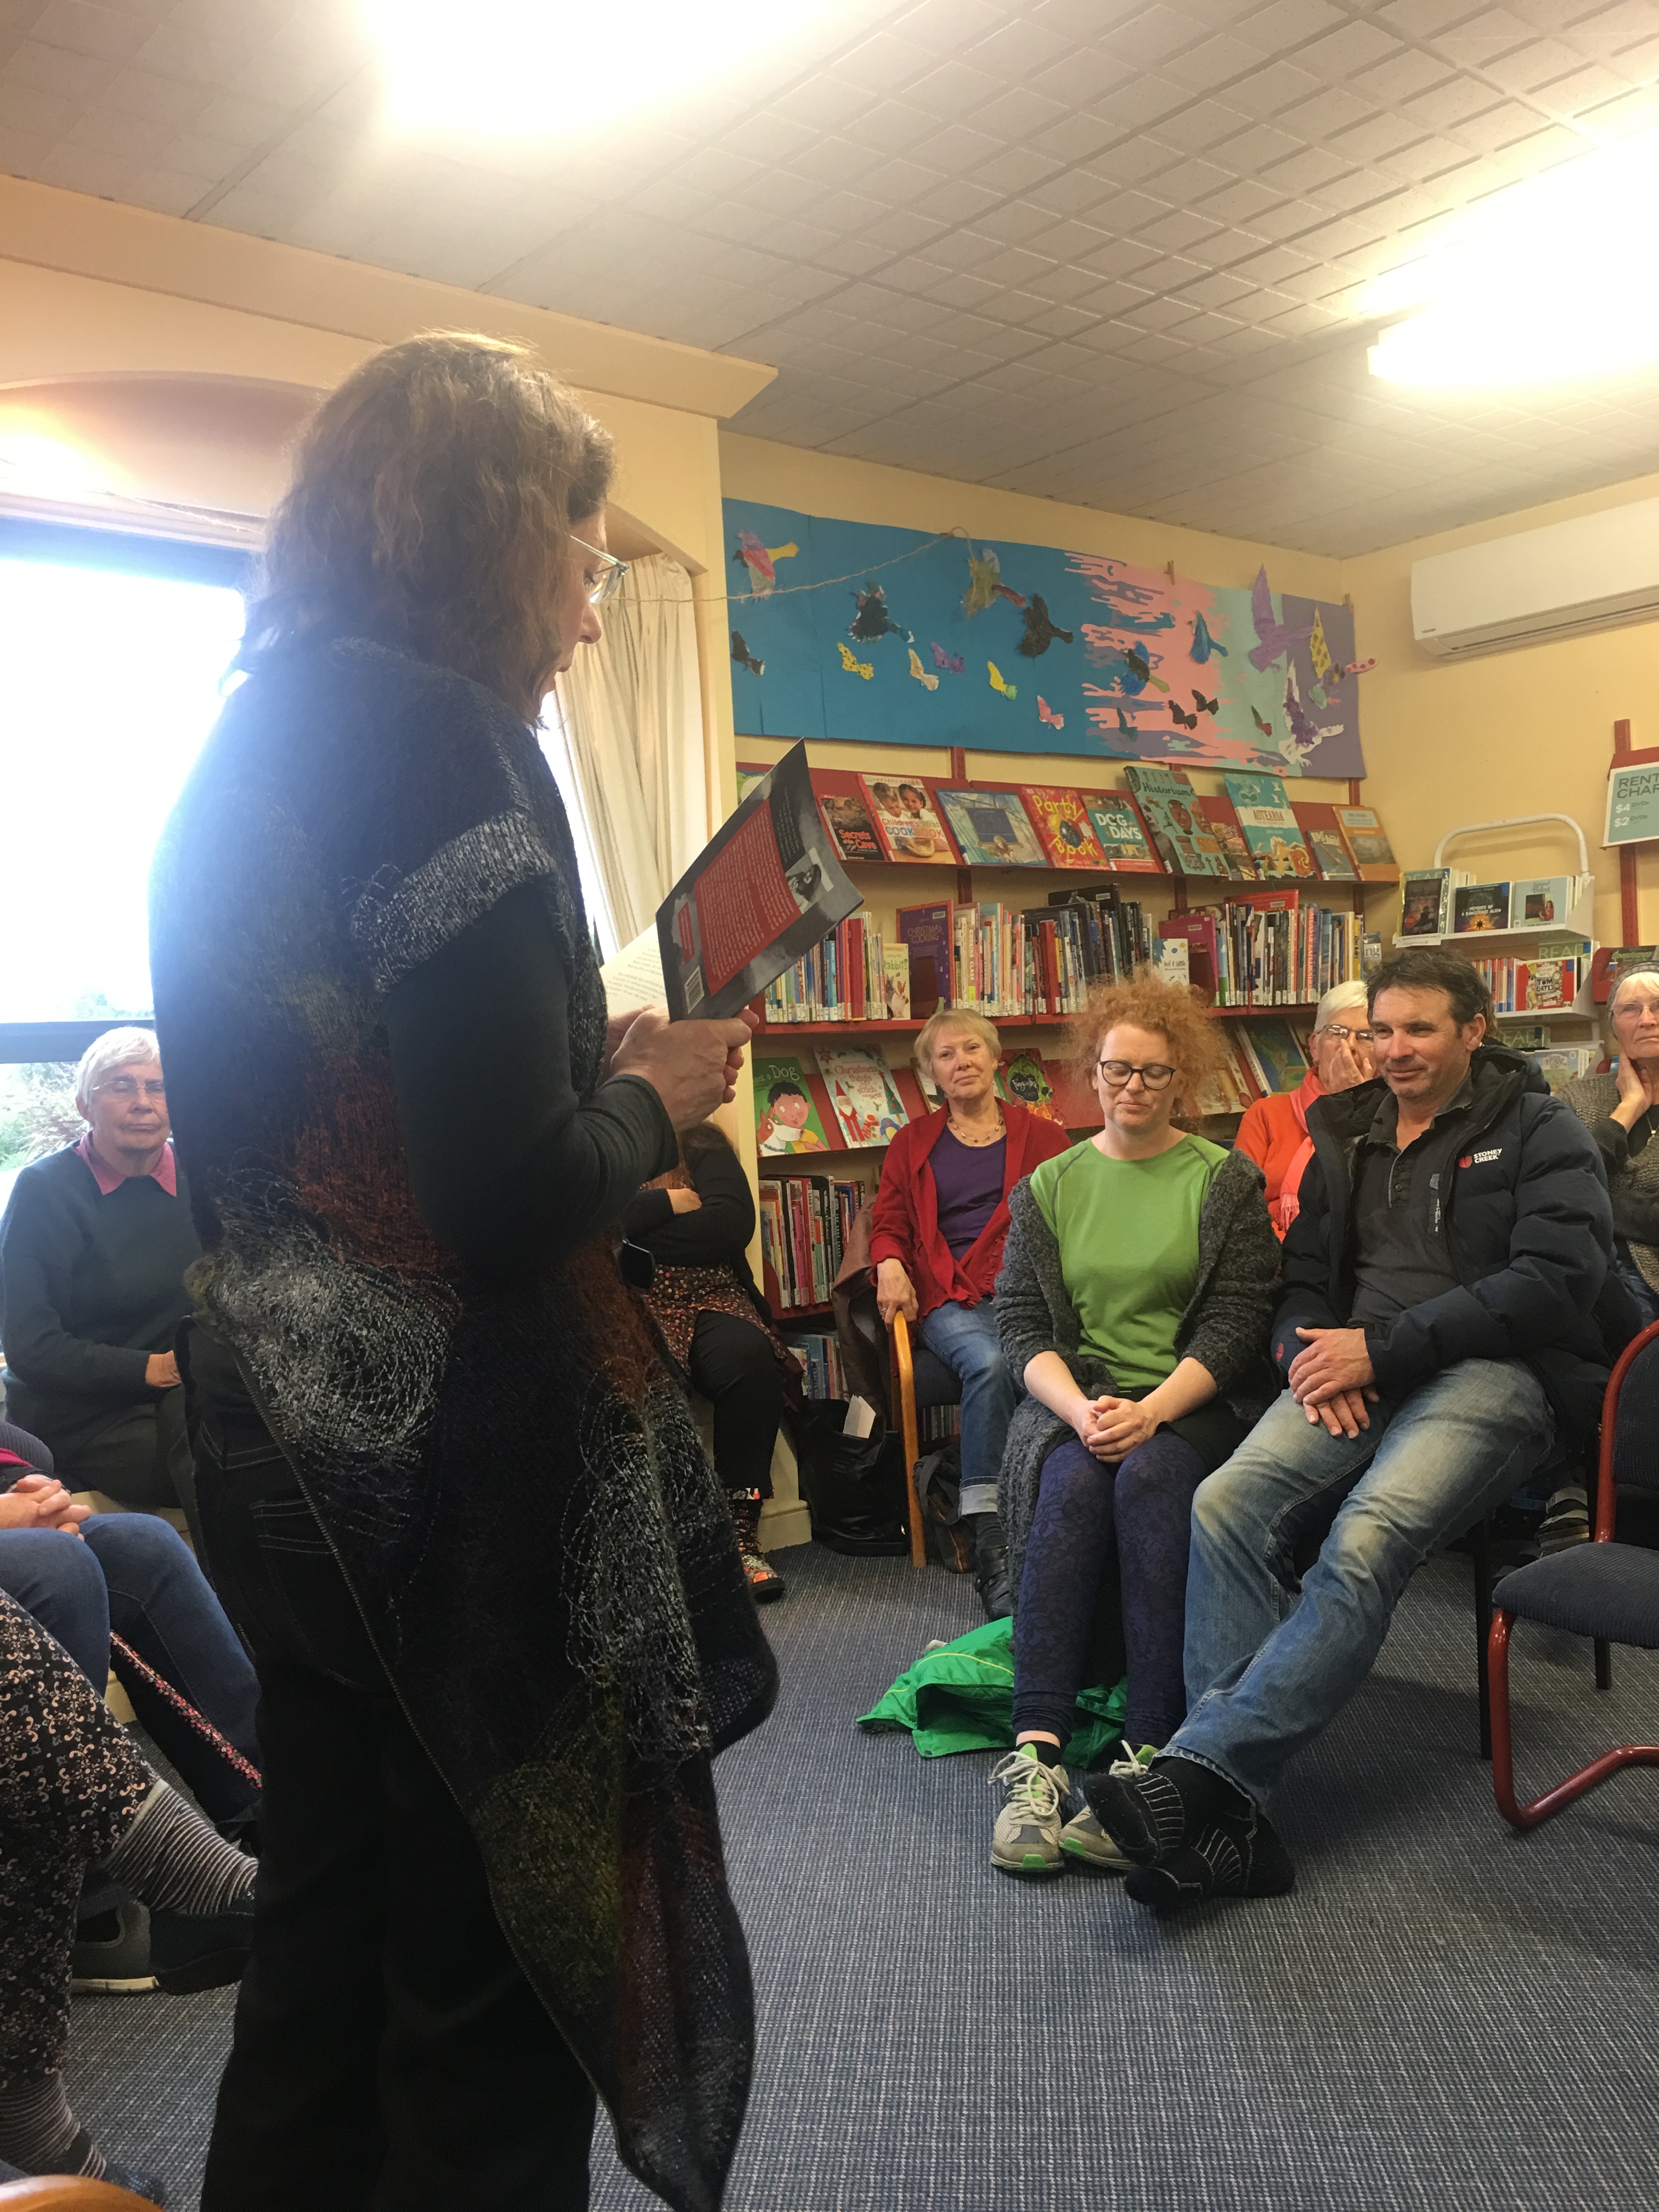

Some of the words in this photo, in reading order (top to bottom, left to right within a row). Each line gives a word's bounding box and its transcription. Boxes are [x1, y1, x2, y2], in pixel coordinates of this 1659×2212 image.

[1142, 782, 1191, 797] Historium
[1032, 795, 1077, 816] Party
[1616, 803, 1630, 814] $4
[1253, 809, 1285, 821] AOTEAROA
[1614, 817, 1629, 827] $2
[838, 829, 871, 840] Secrets
[885, 826, 944, 837] COOKBOOK
[1109, 826, 1142, 840] DAYS
[855, 839, 877, 850] Cave
[1054, 836, 1098, 856] Book
[907, 924, 943, 936] CHRISTMAS
[911, 934, 939, 944] COOKING
[754, 1074, 766, 1083] ant
[769, 1064, 800, 1081] Dog
[834, 1064, 878, 1075] Christmas
[849, 1074, 872, 1082] things
[857, 1086, 877, 1094] stitch
[1473, 1148, 1503, 1159] STONEY
[1474, 1154, 1499, 1164] CREEK
